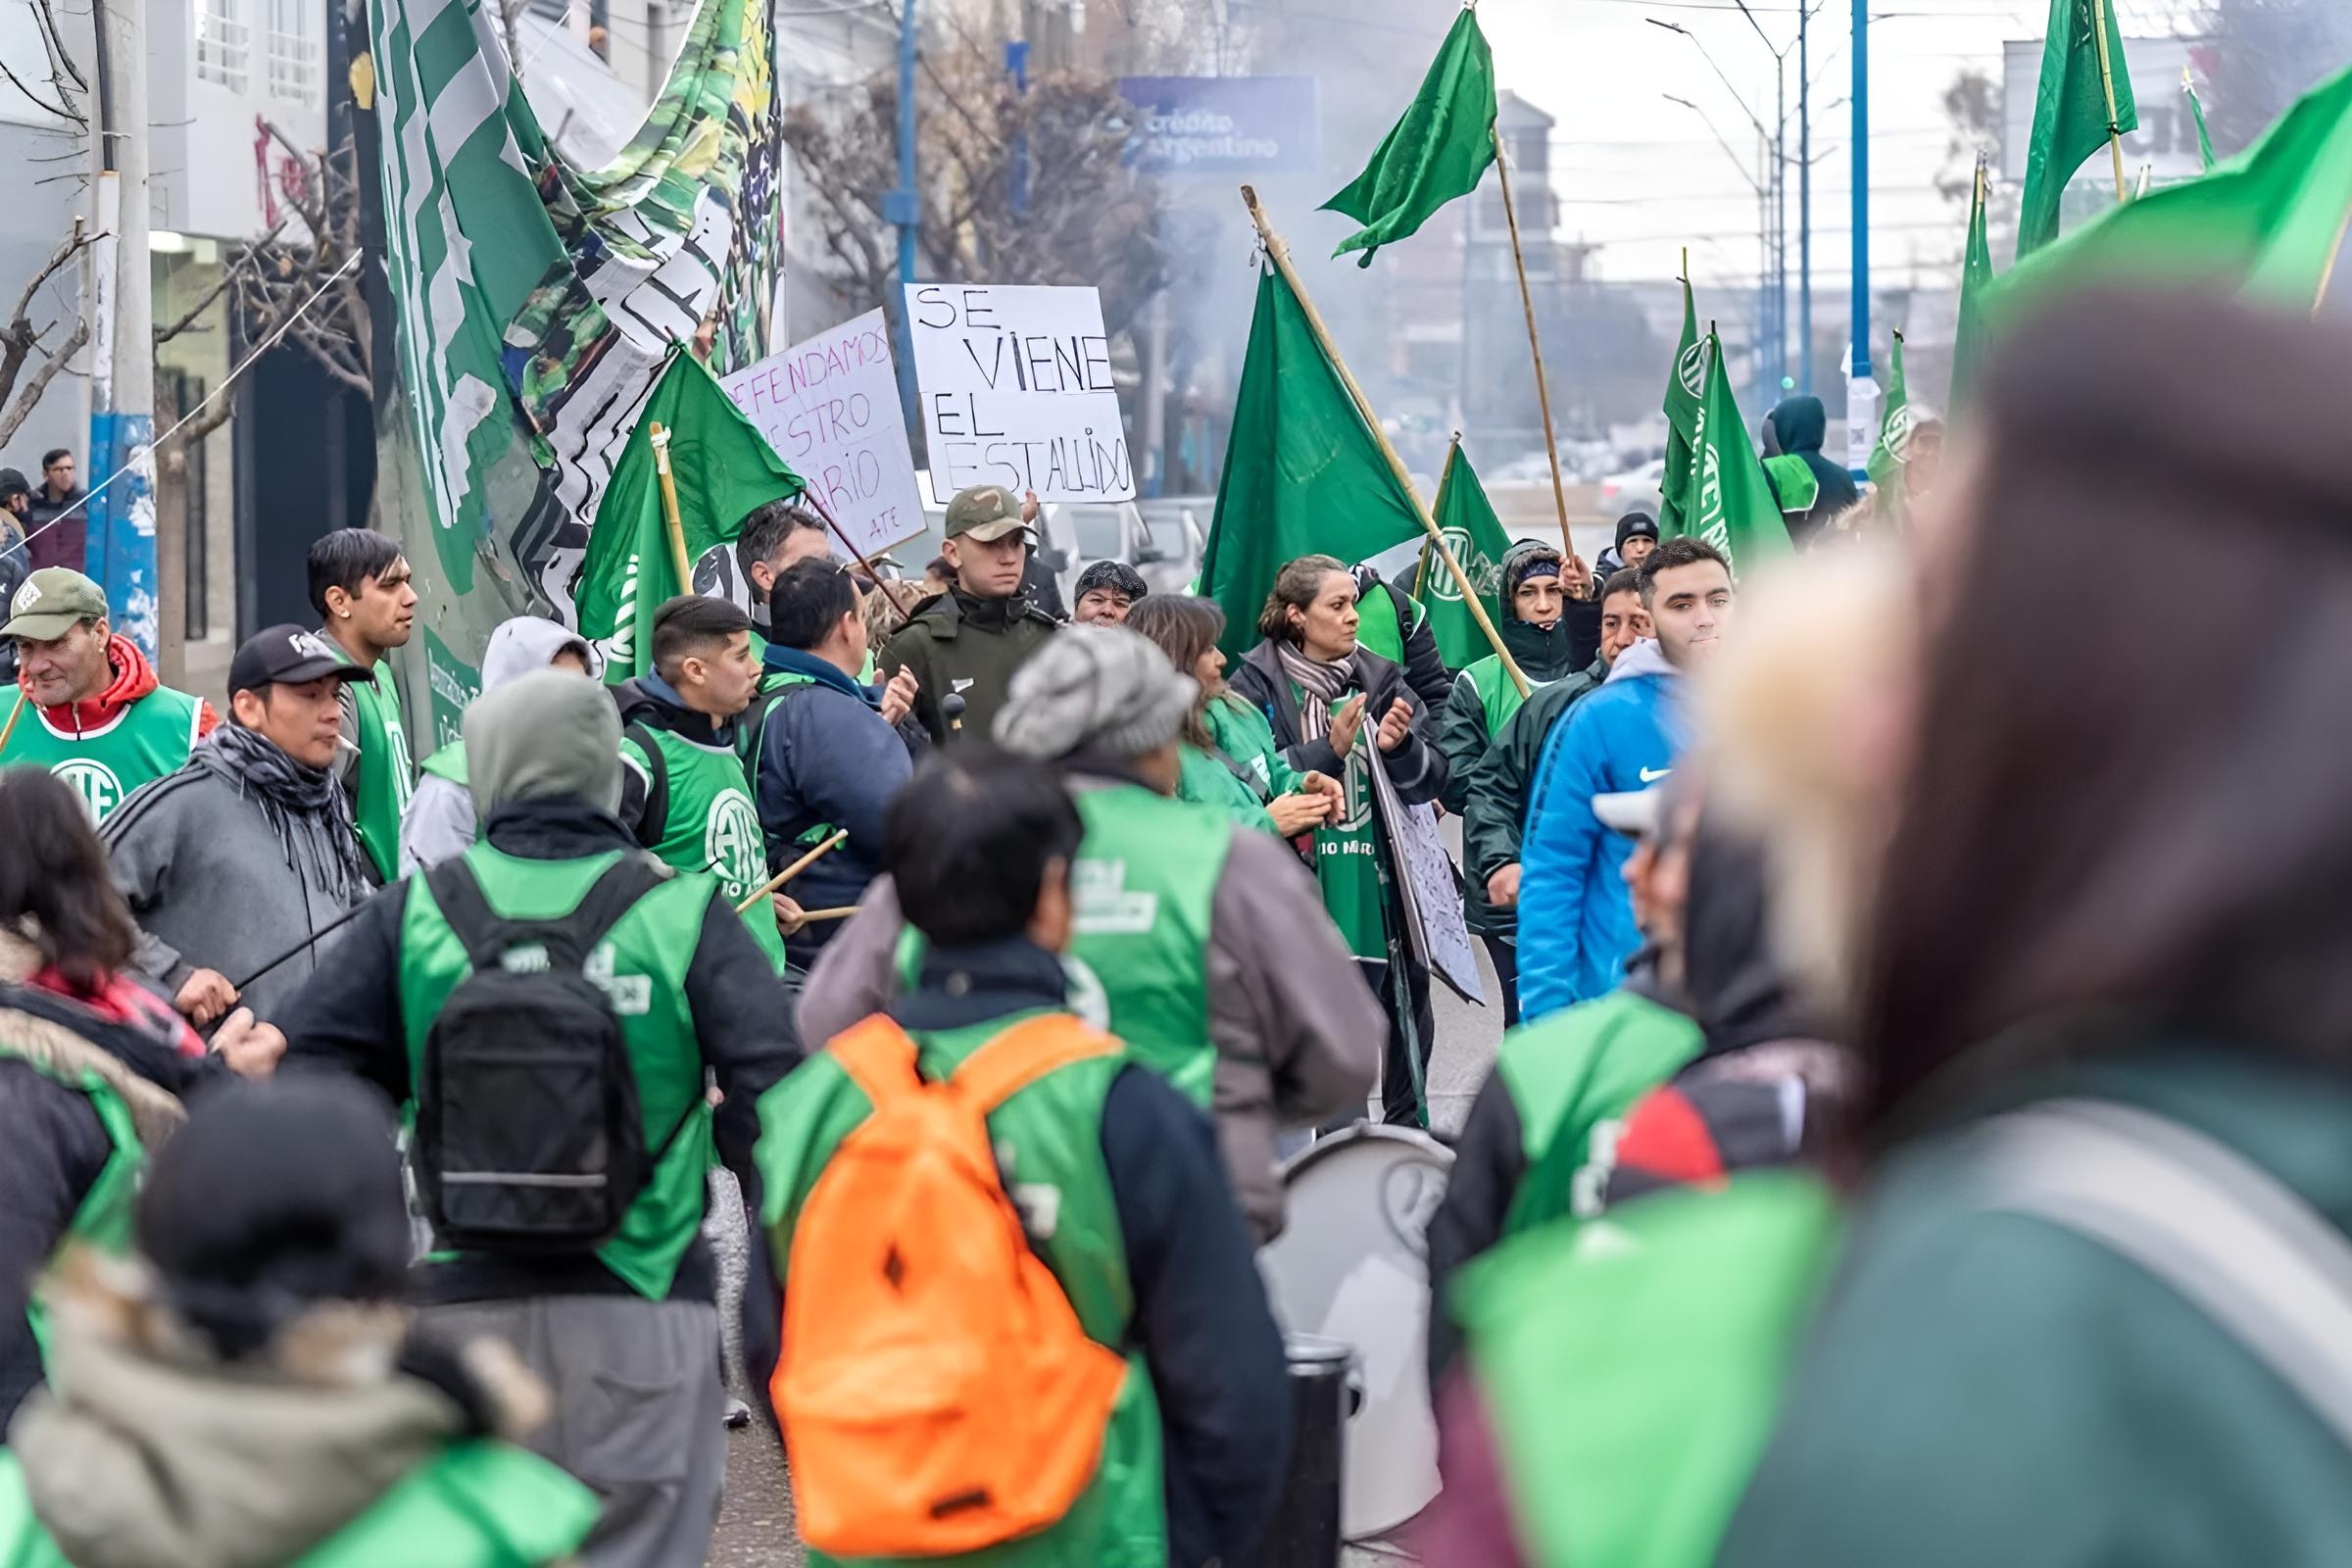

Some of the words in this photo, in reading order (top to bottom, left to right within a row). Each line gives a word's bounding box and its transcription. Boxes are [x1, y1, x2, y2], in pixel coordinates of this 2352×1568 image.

[916, 287, 1002, 329] SE
[728, 324, 891, 416] EFENDAMOS
[935, 392, 1005, 437] EL
[869, 507, 902, 537] ATE
